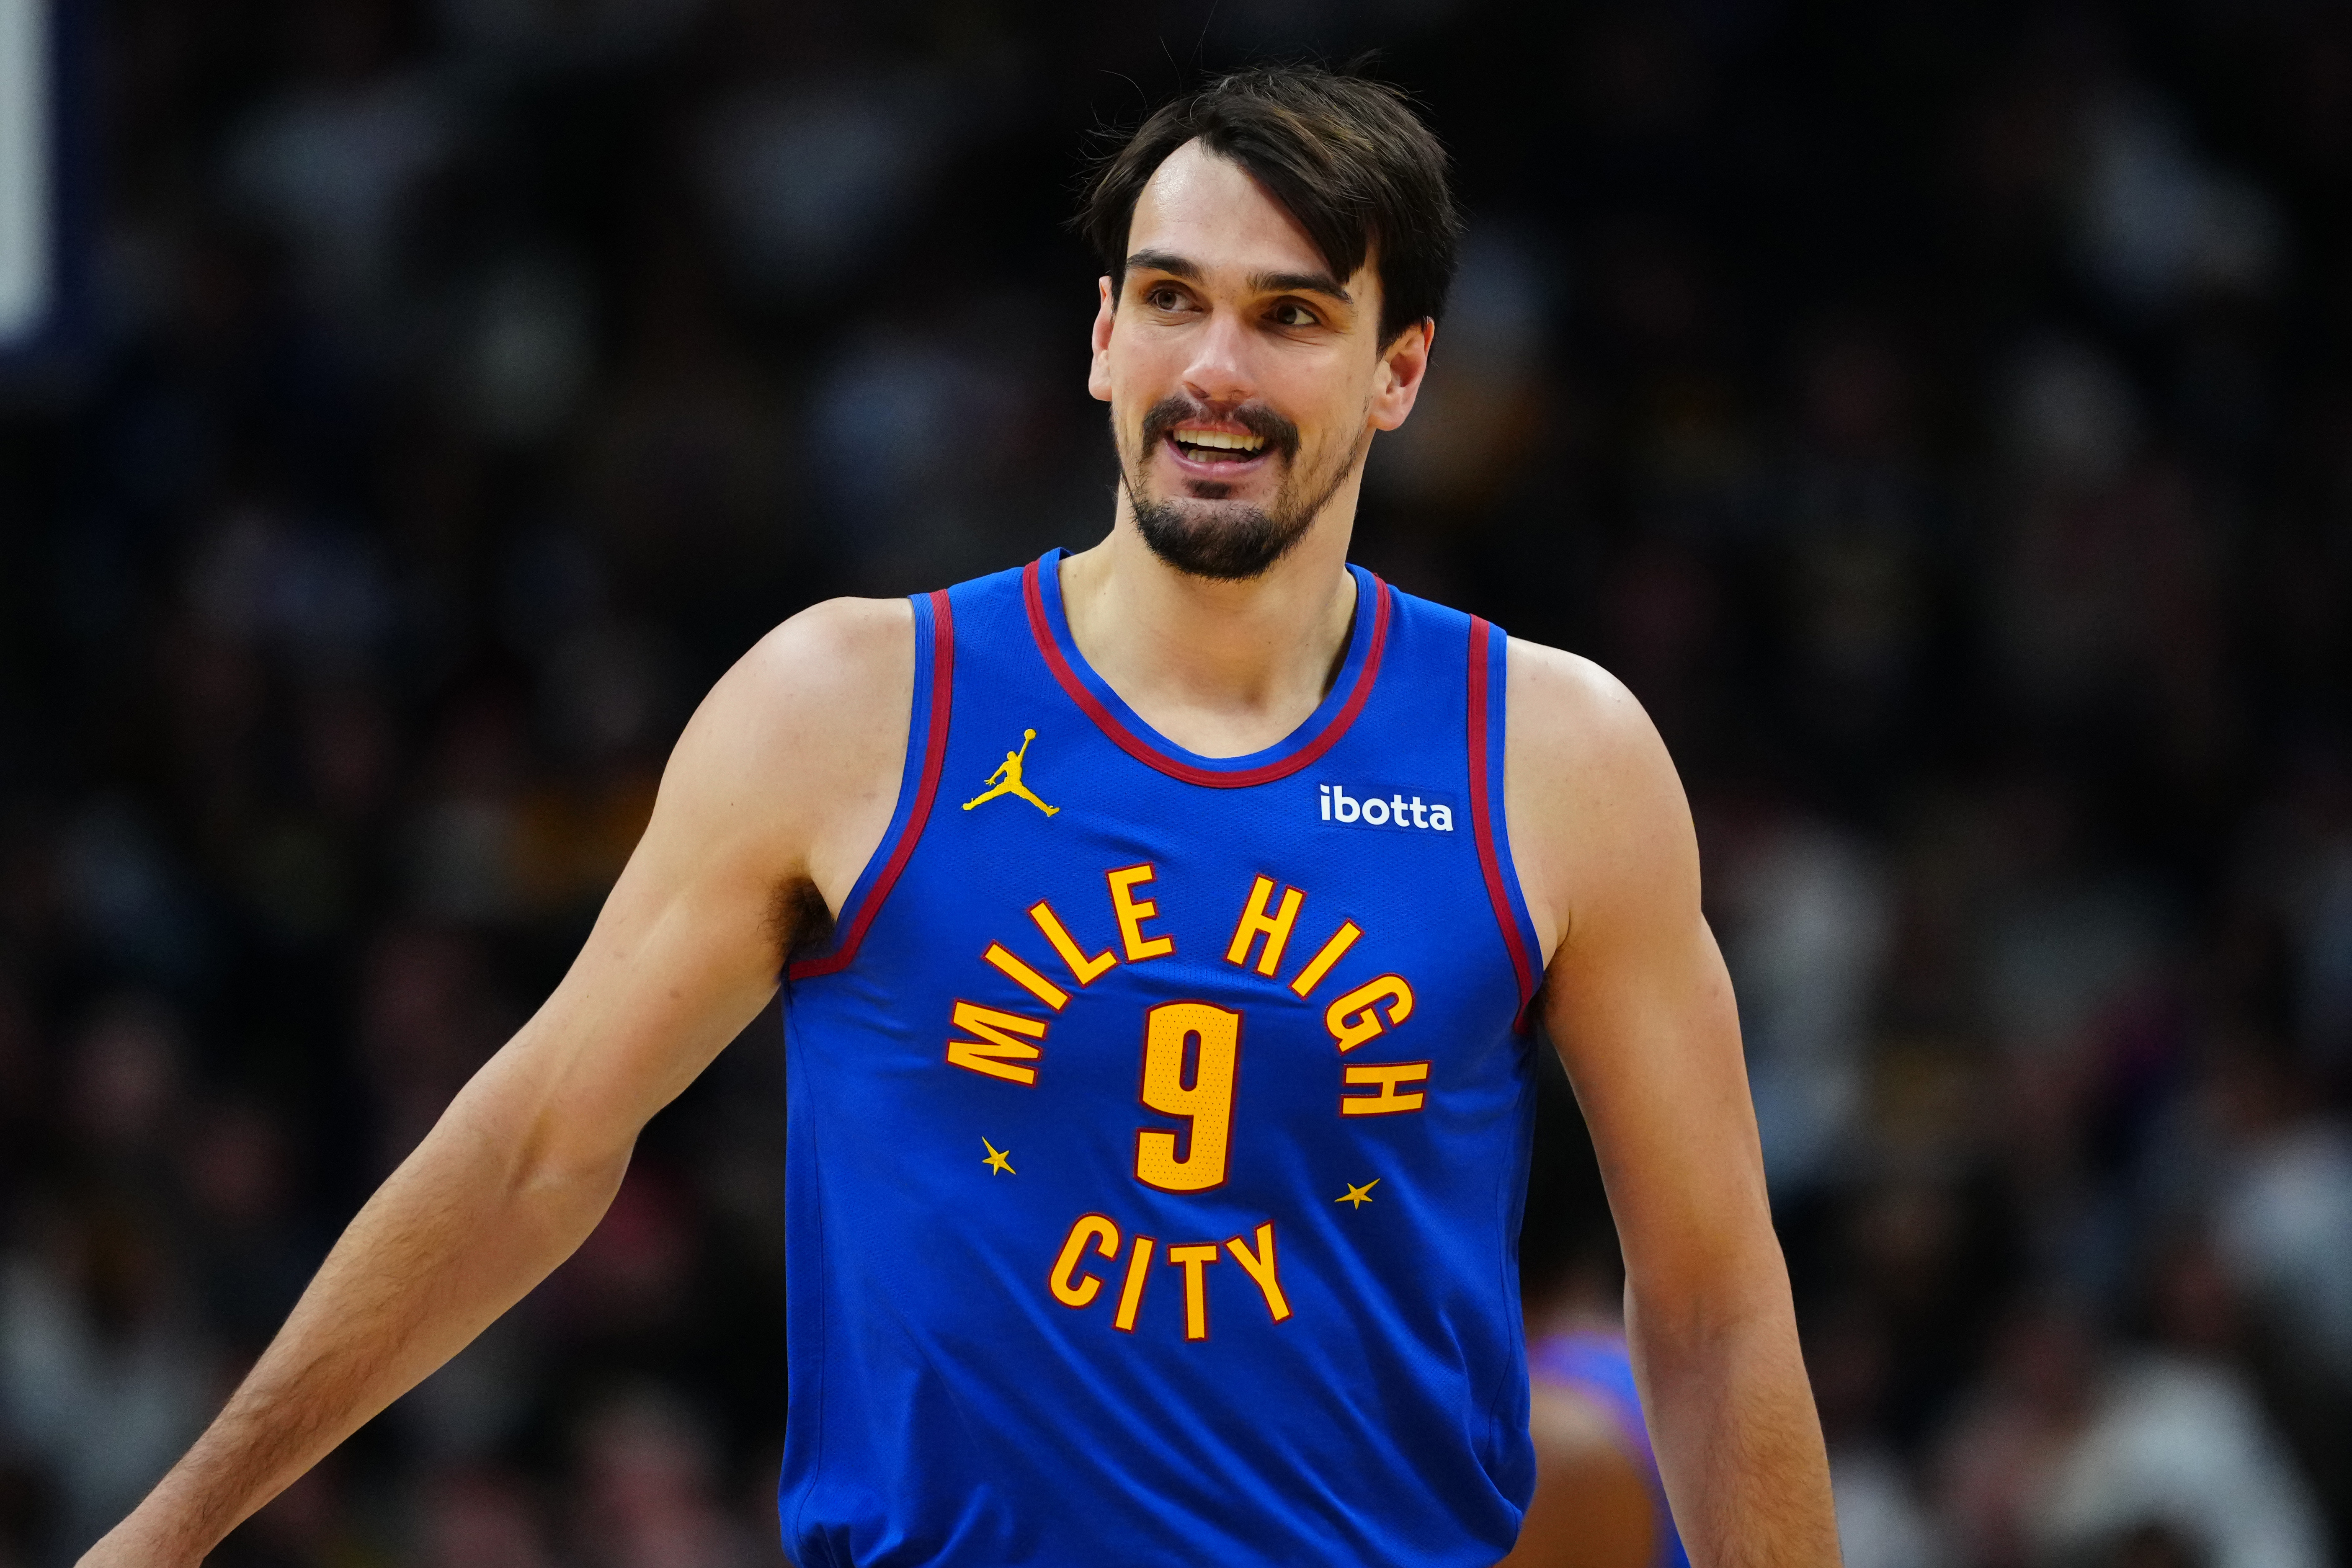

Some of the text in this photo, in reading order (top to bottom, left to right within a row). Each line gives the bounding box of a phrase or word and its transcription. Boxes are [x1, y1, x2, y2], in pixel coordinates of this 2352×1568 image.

[1320, 784, 1454, 831] ibotta
[945, 861, 1431, 1117] MILE HIGH
[1133, 1000, 1244, 1194] 9
[1047, 1212, 1293, 1342] CITY
